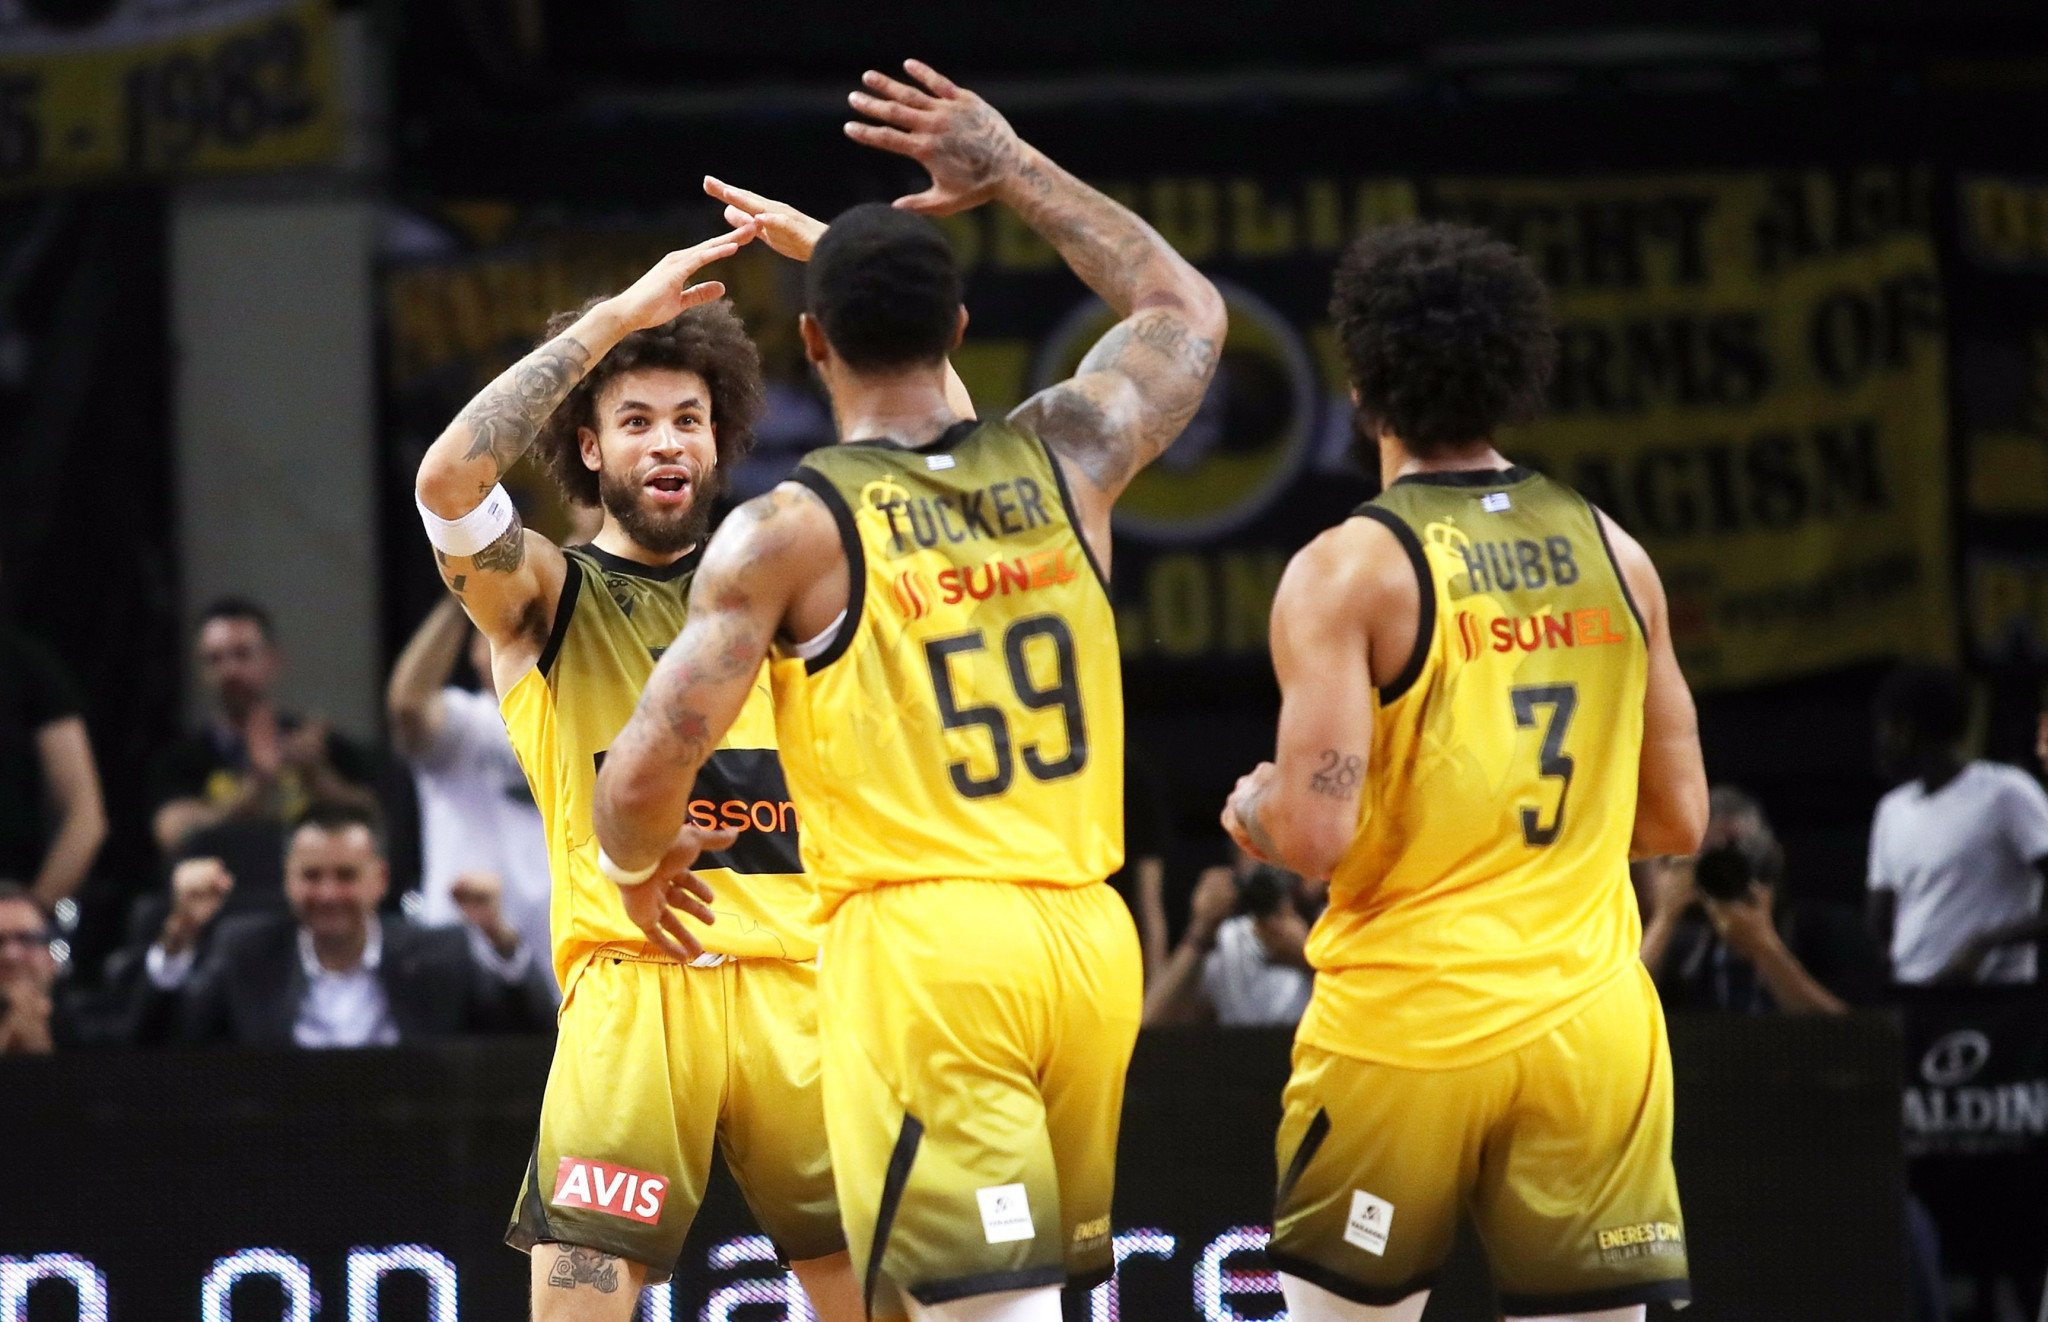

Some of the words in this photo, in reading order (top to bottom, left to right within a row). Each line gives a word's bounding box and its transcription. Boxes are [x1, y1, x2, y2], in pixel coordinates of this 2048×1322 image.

[1550, 312, 1770, 414] RMS
[875, 476, 1052, 552] TUCKER
[937, 549, 1077, 606] SUNEL
[1459, 534, 1581, 593] HUBB
[1490, 607, 1625, 654] SUNEL
[921, 611, 1090, 801] 59
[1510, 678, 1578, 848] 3
[687, 799, 799, 834] sson
[557, 1163, 665, 1219] AVIS
[1598, 1223, 1657, 1250] ENERES
